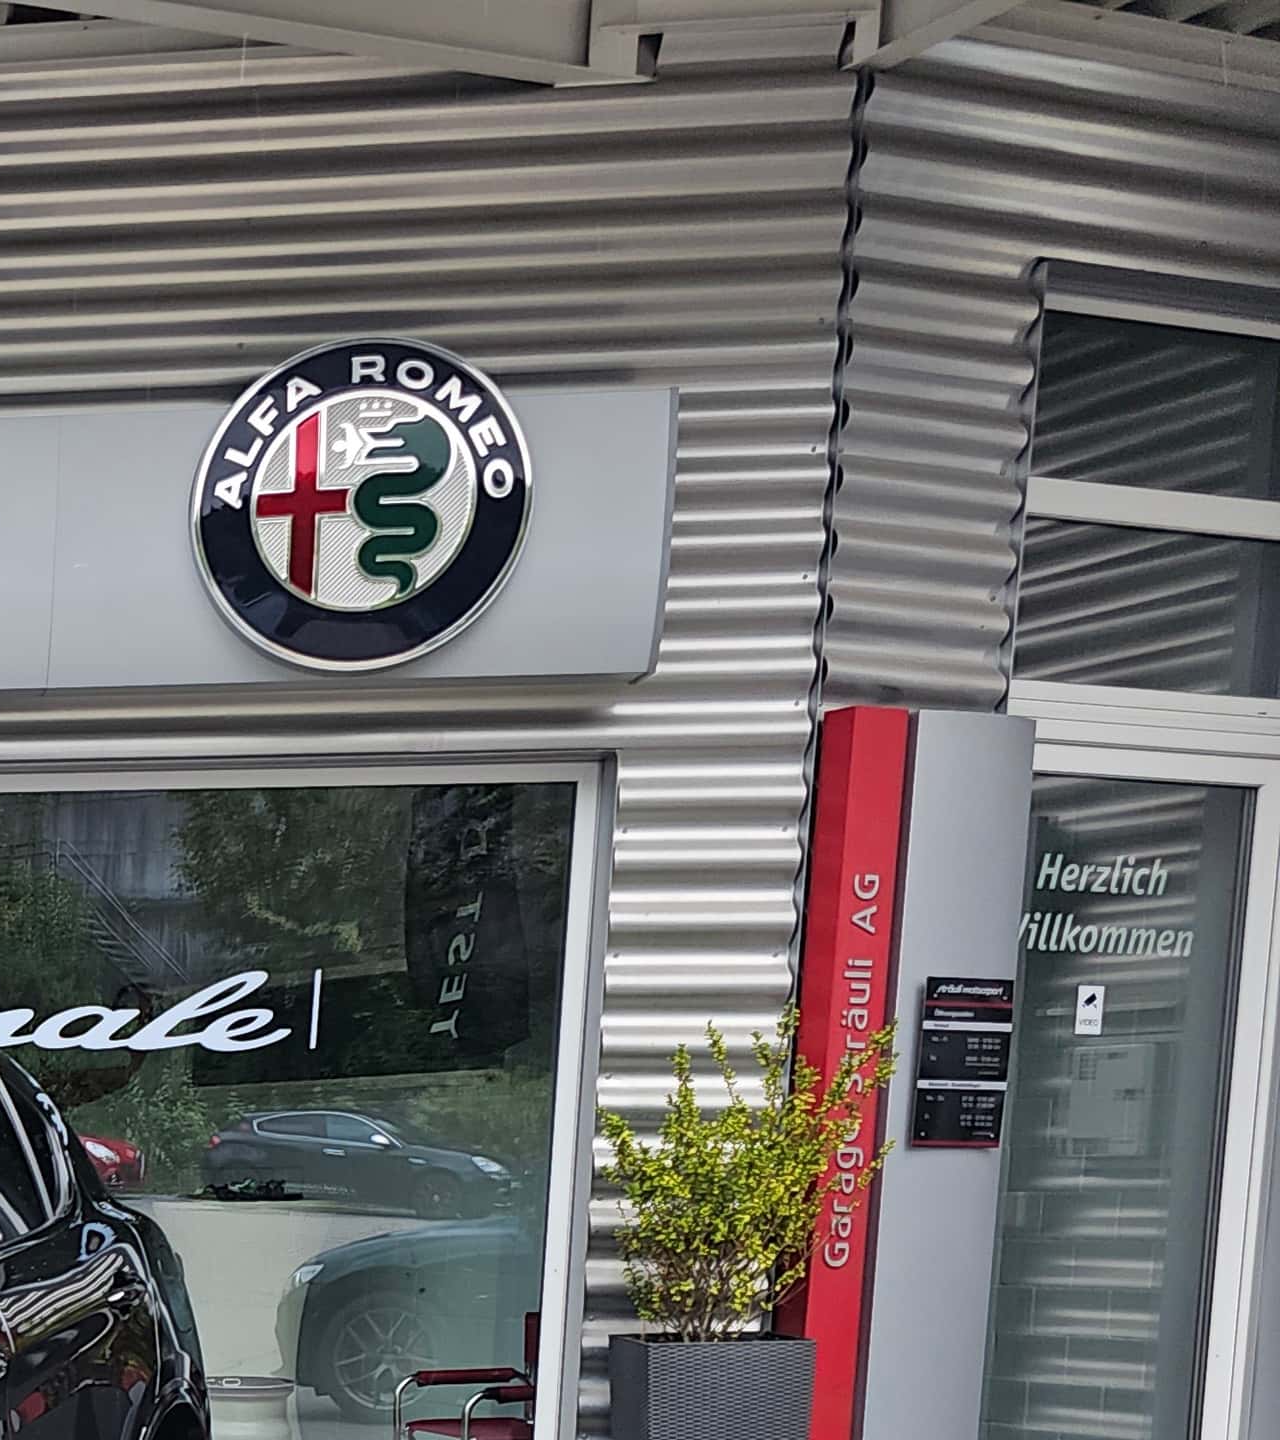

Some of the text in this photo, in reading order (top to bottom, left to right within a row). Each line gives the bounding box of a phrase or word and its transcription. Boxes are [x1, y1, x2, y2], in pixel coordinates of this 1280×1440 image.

[214, 354, 515, 509] ALFA ROMEO
[1036, 853, 1168, 896] Herzlich
[851, 872, 881, 934] AG
[1017, 912, 1195, 958] illkommen
